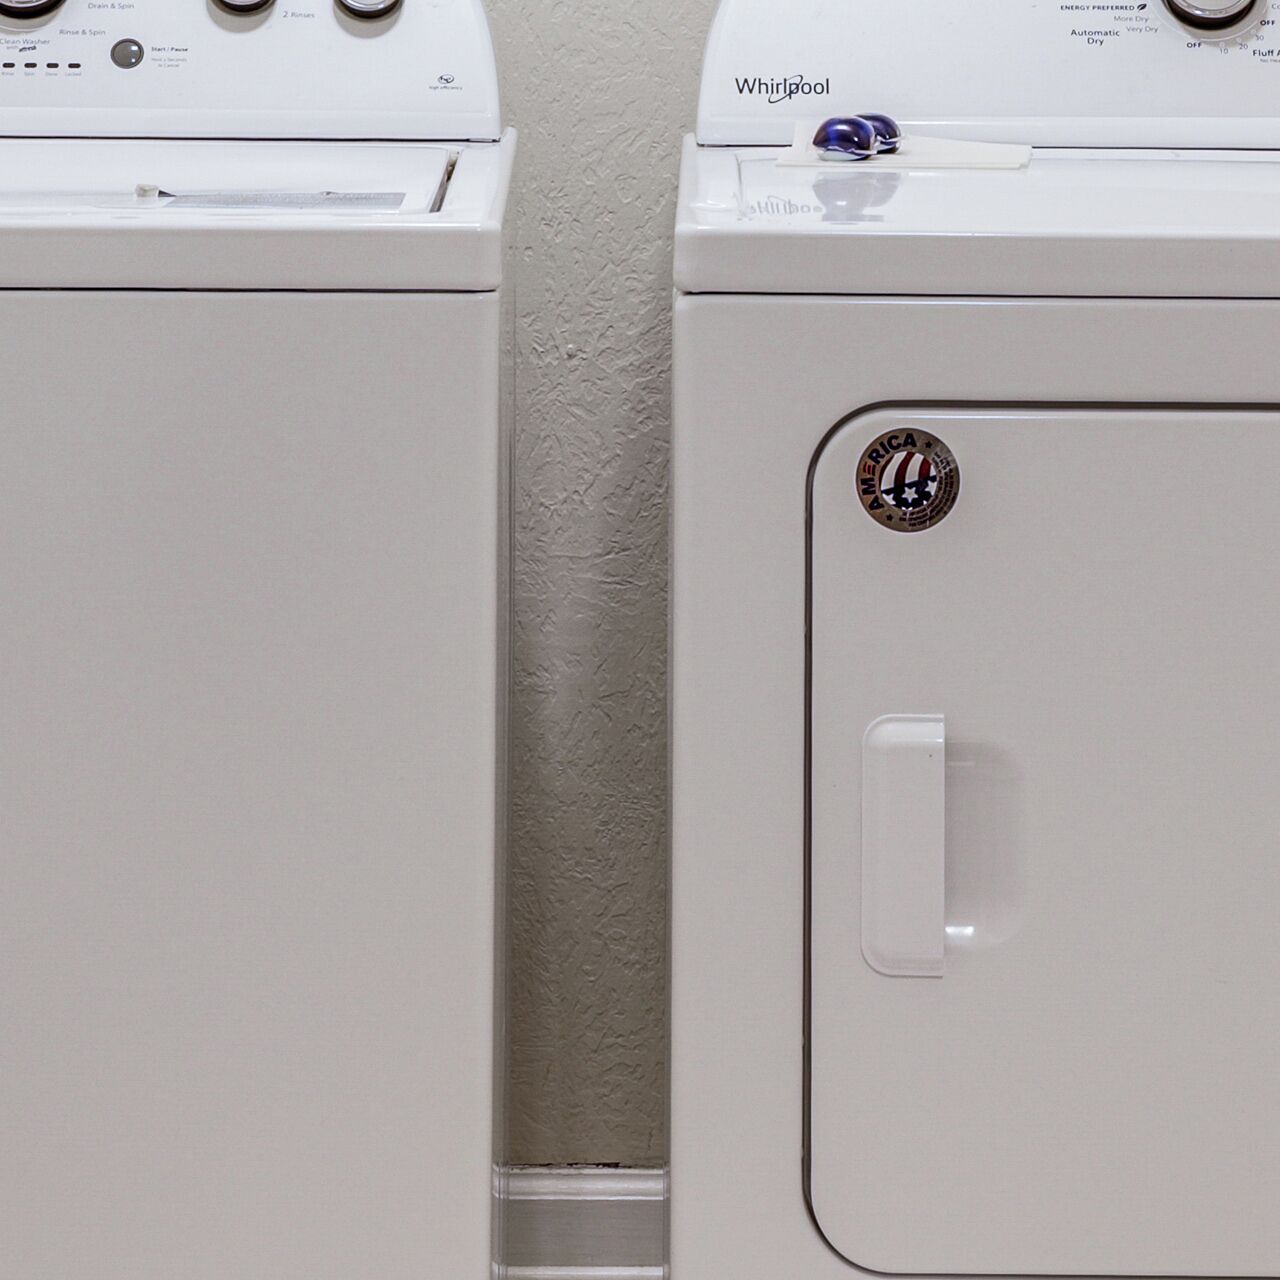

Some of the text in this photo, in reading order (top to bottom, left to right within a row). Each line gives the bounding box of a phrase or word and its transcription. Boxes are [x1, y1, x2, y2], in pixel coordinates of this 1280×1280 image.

[1087, 38, 1104, 46] Dry
[735, 74, 829, 103] Whirlpool
[860, 432, 917, 511] AMERICA
